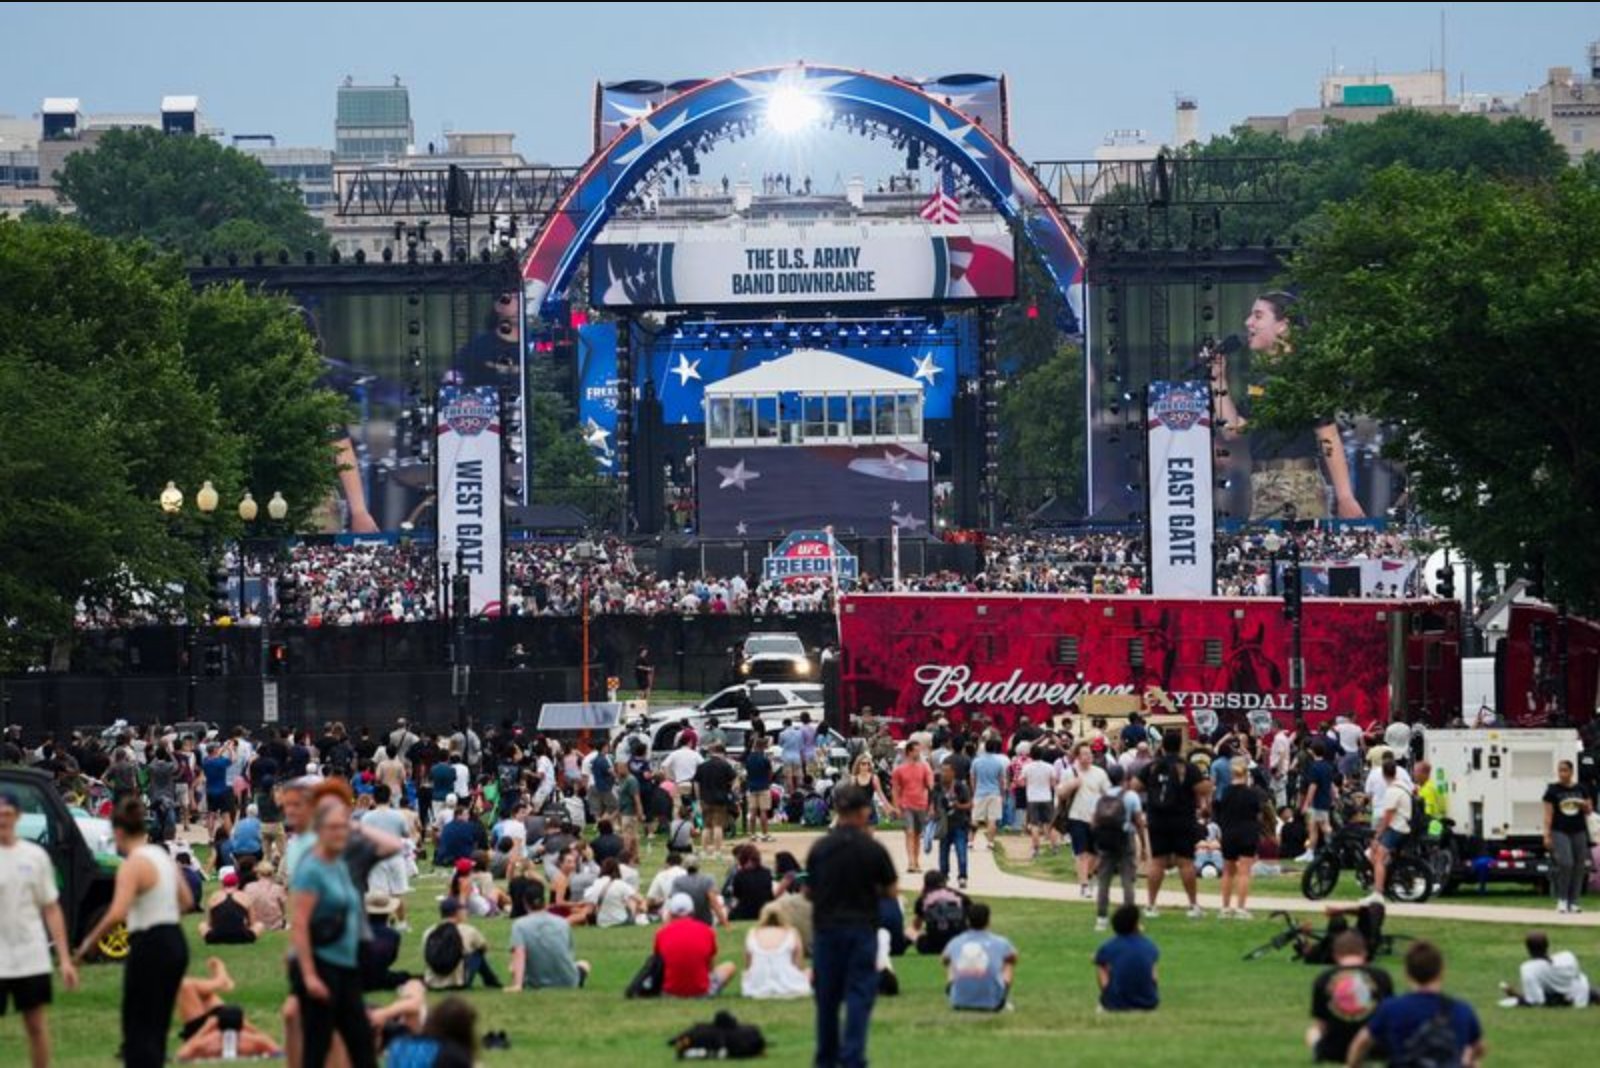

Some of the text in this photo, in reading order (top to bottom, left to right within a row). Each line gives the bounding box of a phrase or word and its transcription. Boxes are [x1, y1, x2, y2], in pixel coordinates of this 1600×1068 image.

[745, 246, 861, 270] THE U.S. ARMY
[732, 271, 876, 295] BAND DOWNRANGE
[587, 387, 640, 400] FREEM
[456, 460, 483, 575] WEST GATE
[1167, 457, 1196, 566] EAST GATE
[797, 545, 823, 555] UFC
[1144, 690, 1328, 711] CYDESDALES
